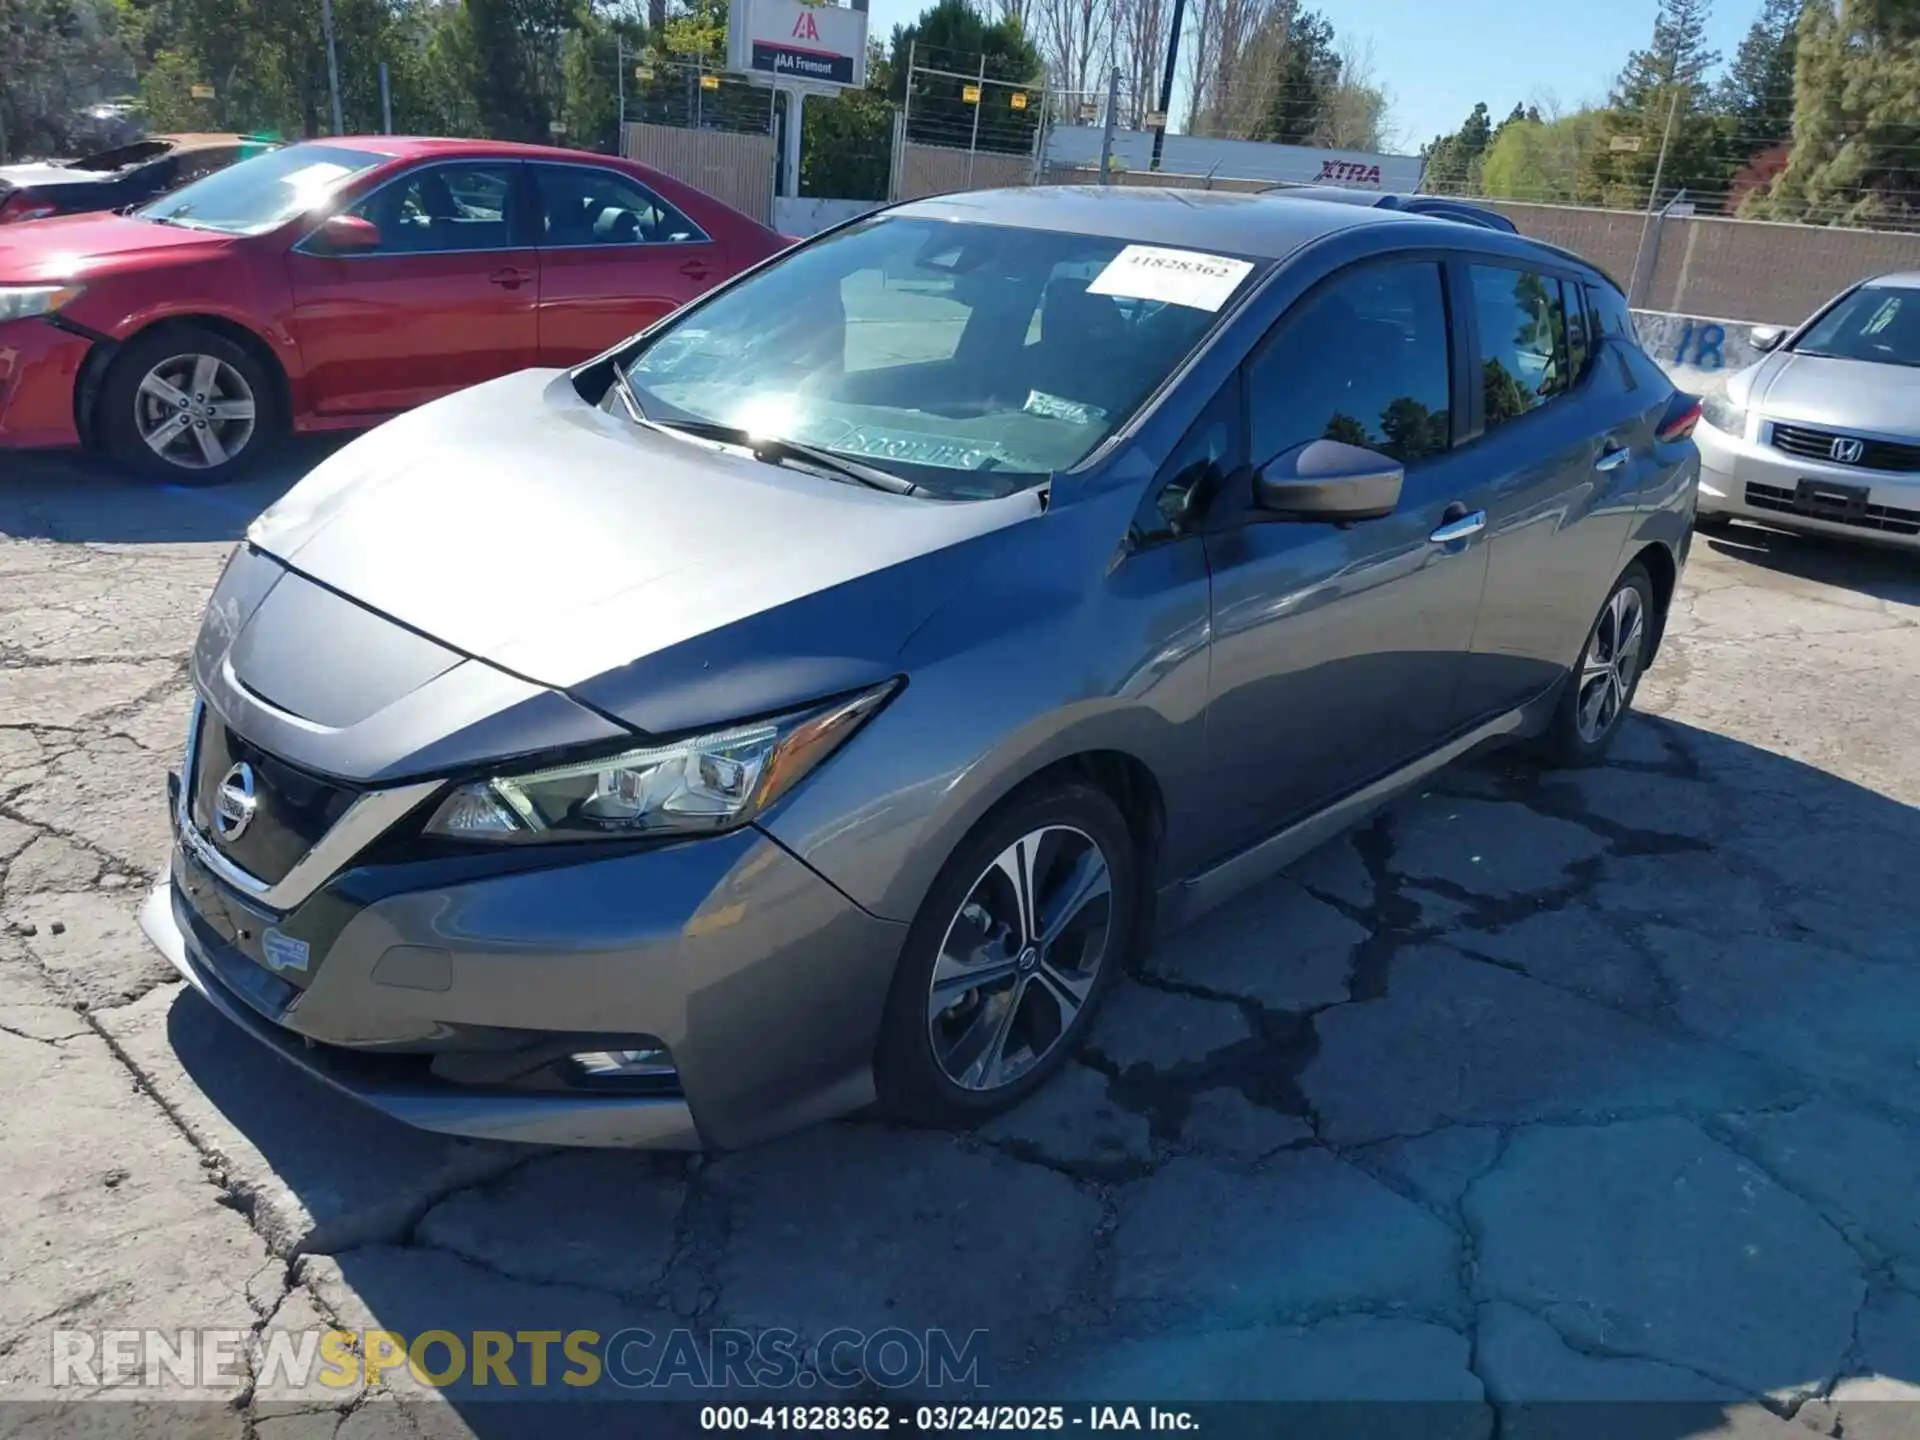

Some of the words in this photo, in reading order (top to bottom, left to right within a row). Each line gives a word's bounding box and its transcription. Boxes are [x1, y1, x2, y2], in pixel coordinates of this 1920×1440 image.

[776, 53, 794, 69] IAA
[796, 56, 833, 74] Fremont
[1312, 160, 1380, 183] XTRA
[1674, 321, 1725, 372] 18
